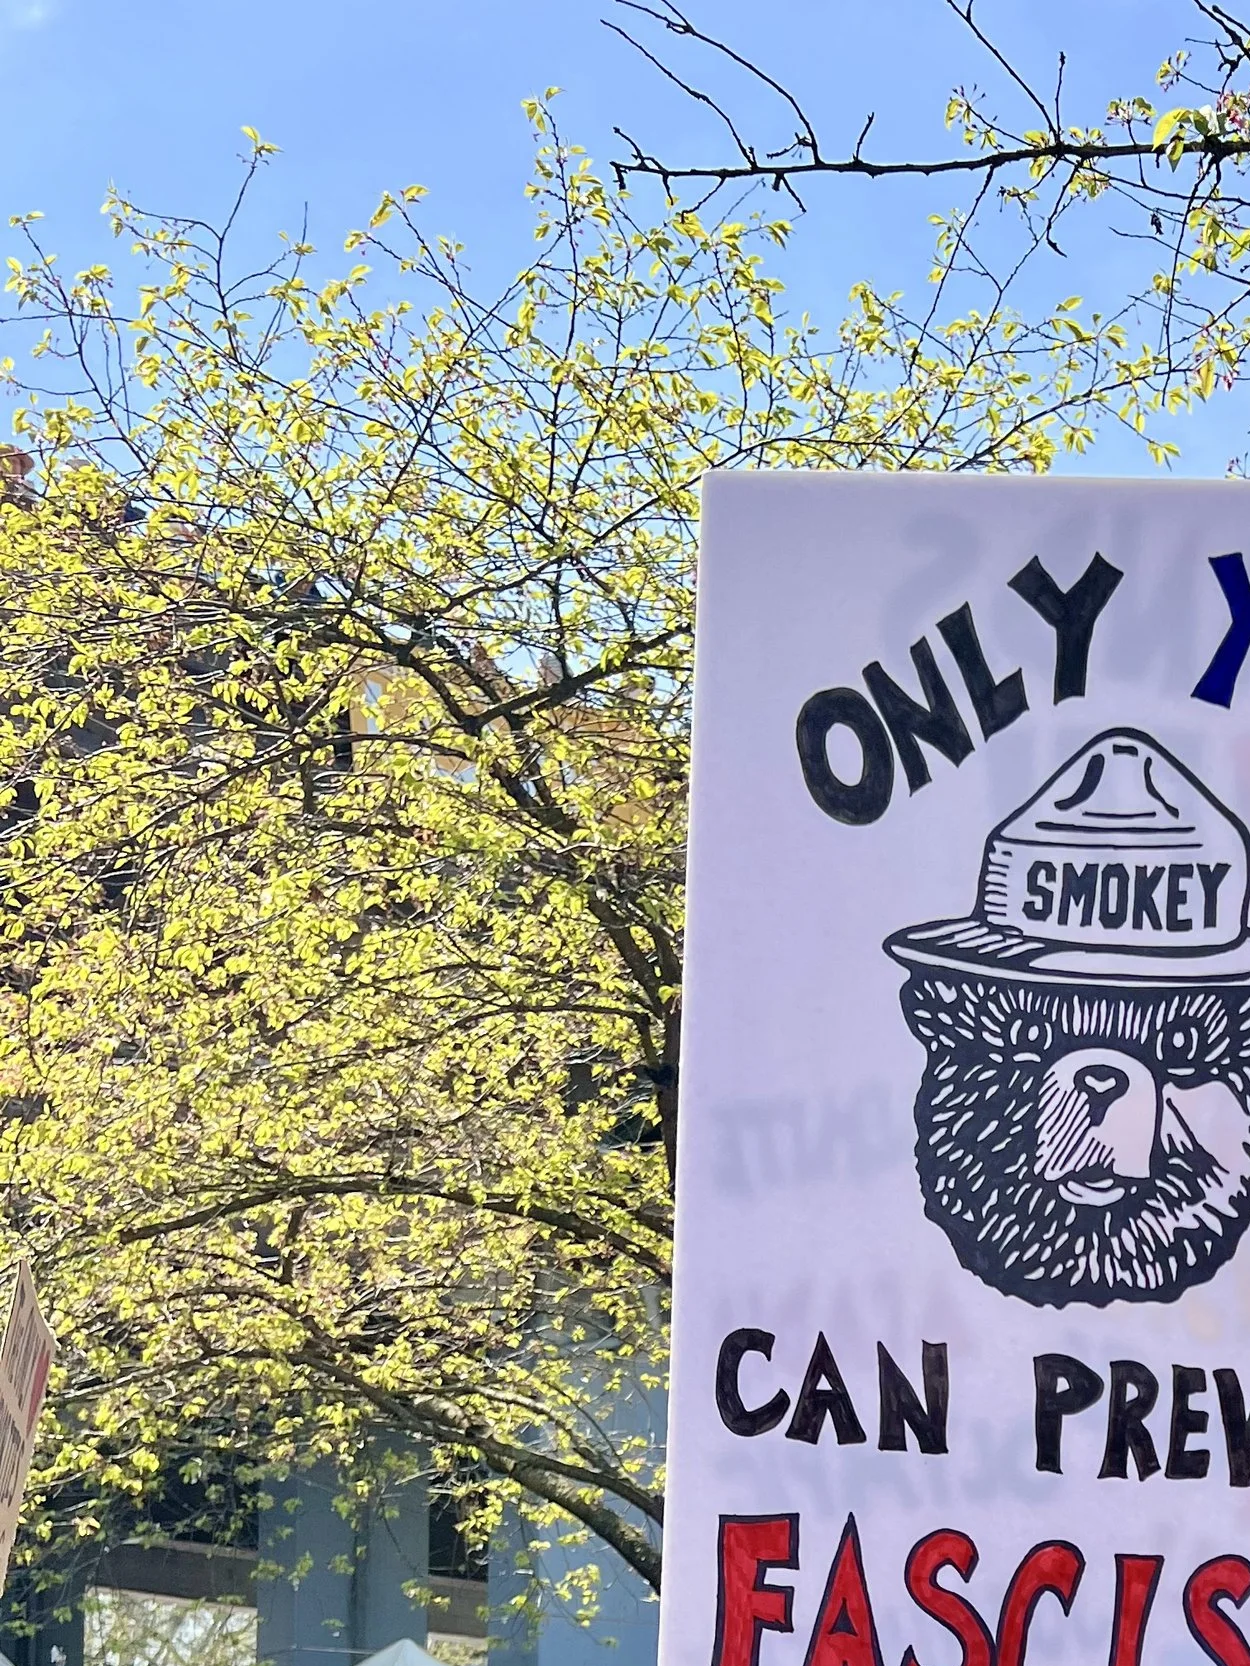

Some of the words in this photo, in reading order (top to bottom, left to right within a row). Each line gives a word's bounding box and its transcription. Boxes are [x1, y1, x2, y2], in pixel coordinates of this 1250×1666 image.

[796, 551, 1124, 826] ONLY
[1023, 860, 1231, 931] SMOKEY
[716, 1328, 949, 1453] CAN
